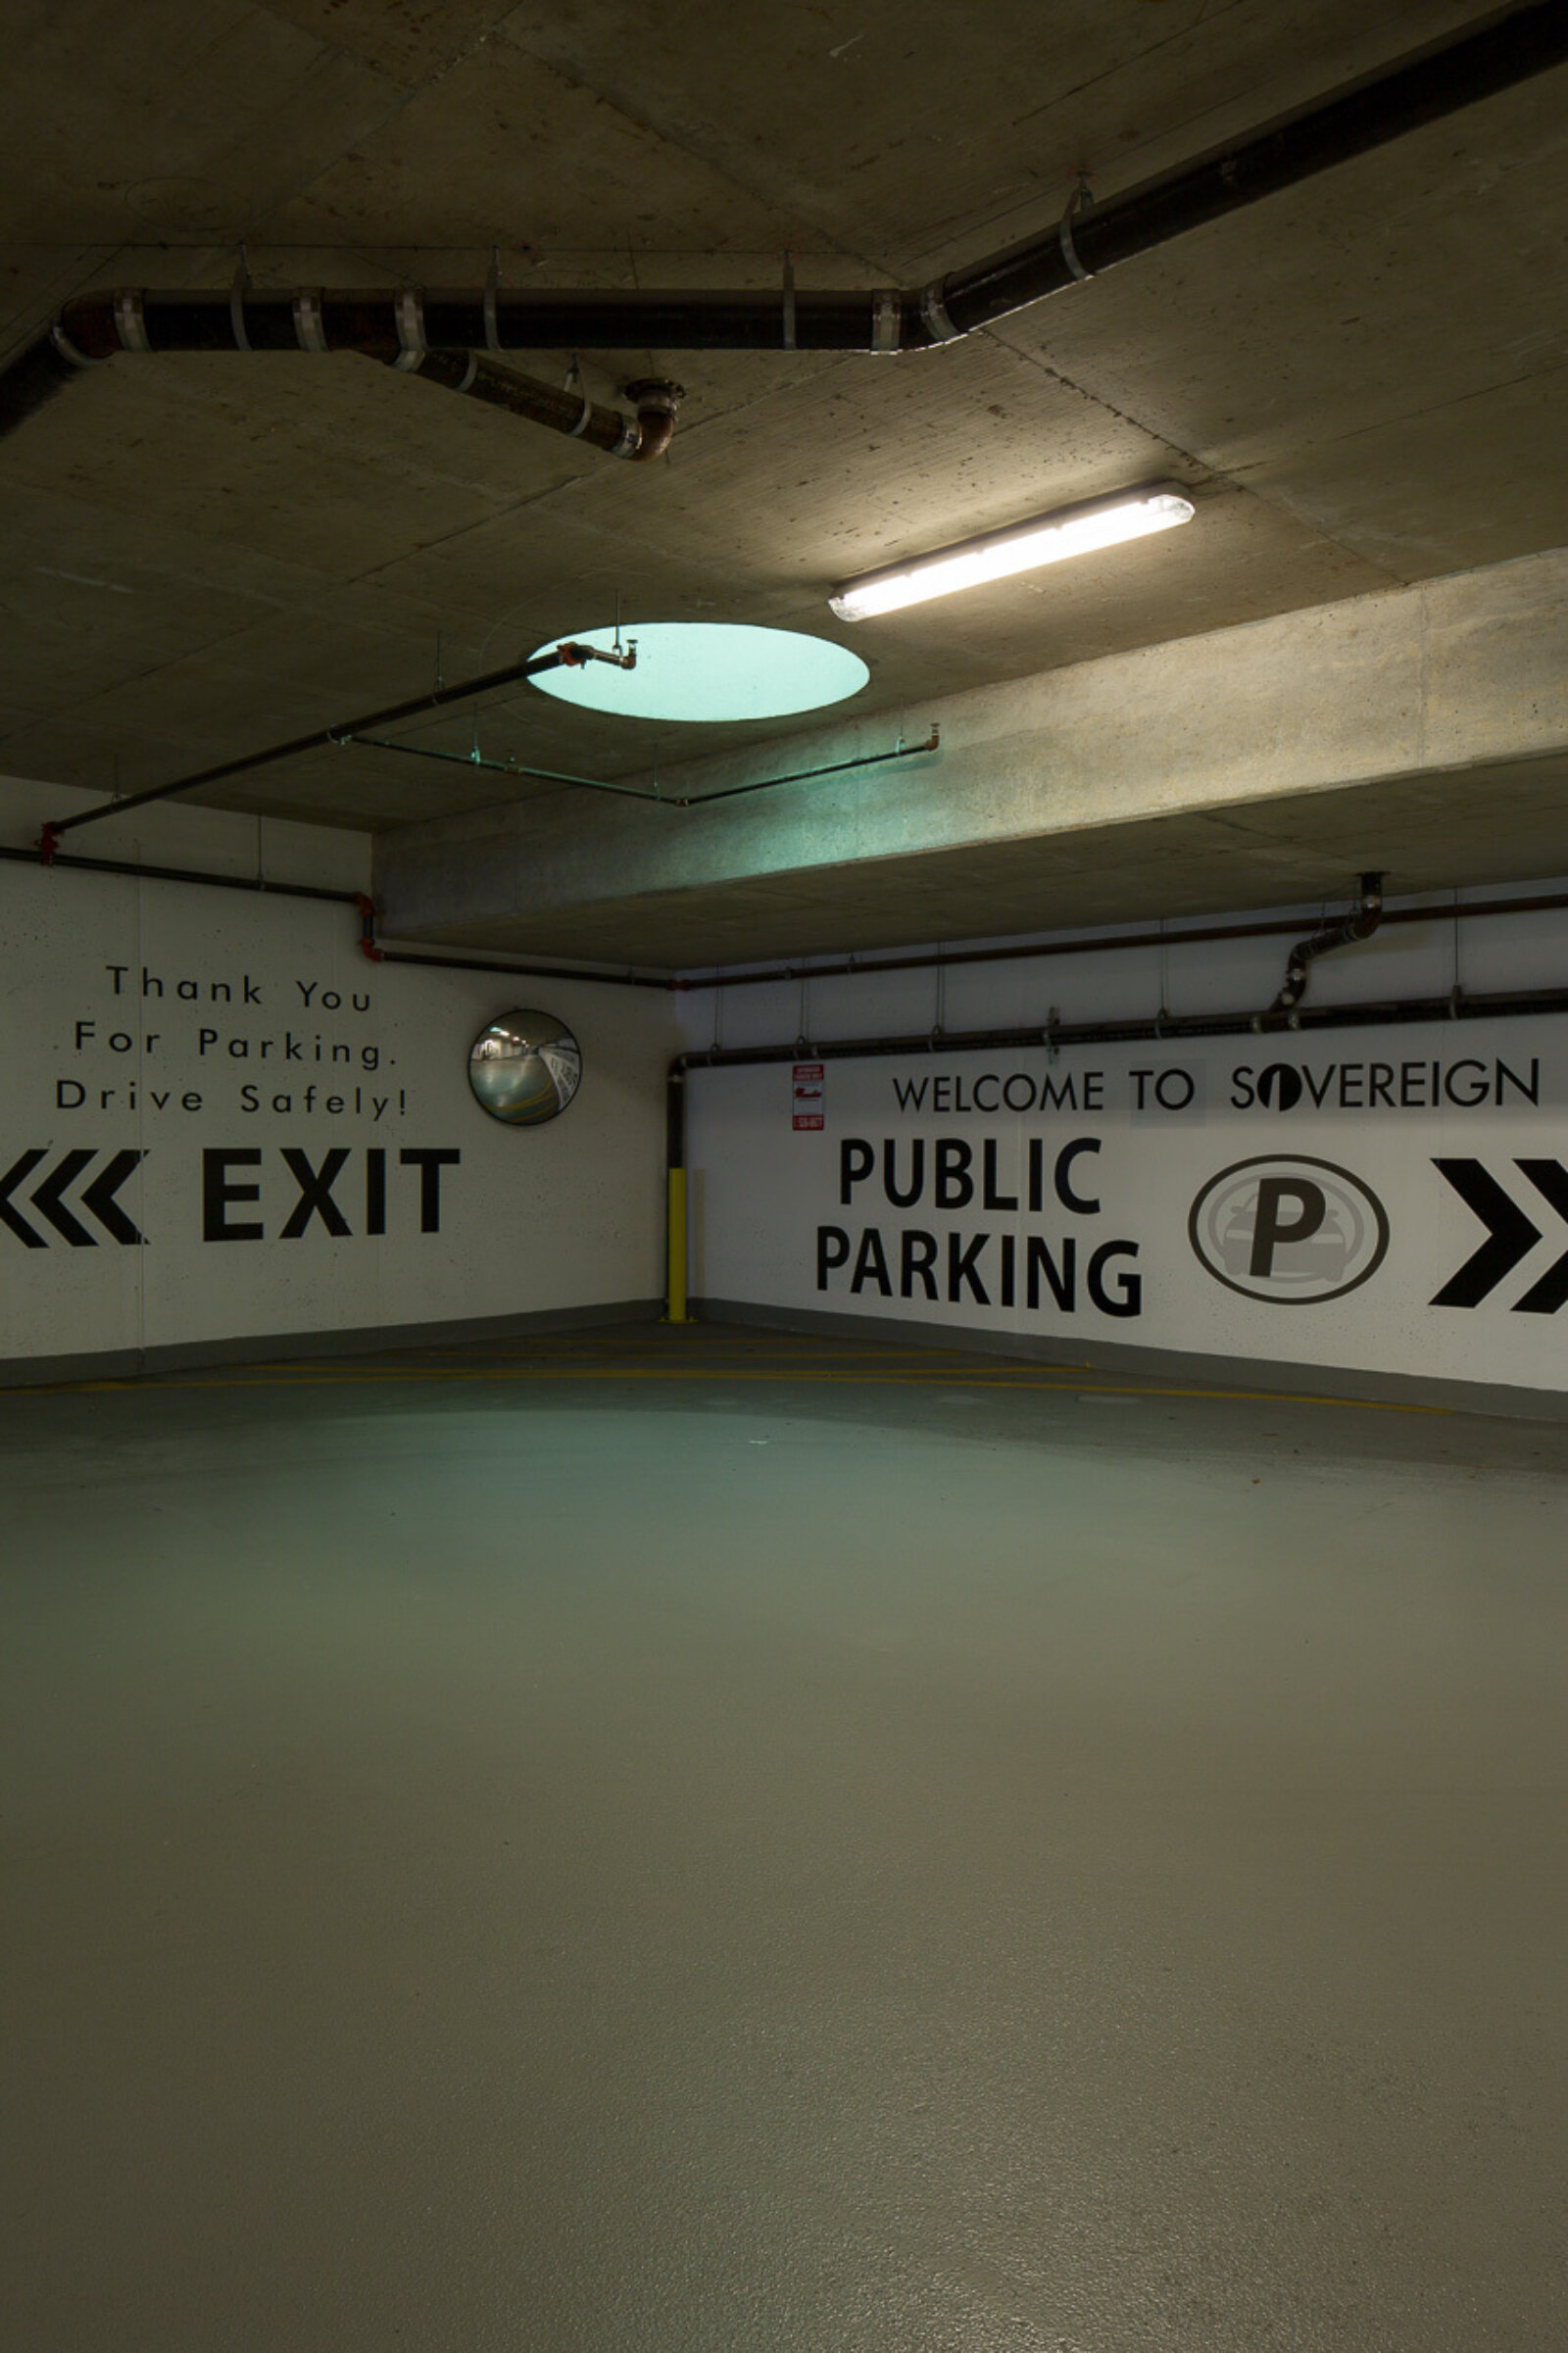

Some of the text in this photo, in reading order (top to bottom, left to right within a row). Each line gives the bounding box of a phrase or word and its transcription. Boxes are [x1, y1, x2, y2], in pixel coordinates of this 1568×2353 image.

[106, 966, 369, 1011] Thank You
[76, 1021, 395, 1070] For Parking.
[57, 1080, 405, 1121] Drive Safely!
[893, 1058, 1539, 1112] WELCOME TO SOVEREIGN
[203, 1149, 460, 1242] EXIT
[841, 1138, 1102, 1214] PUBLIC
[1250, 1178, 1325, 1277] P
[817, 1226, 1141, 1318] PARKING
